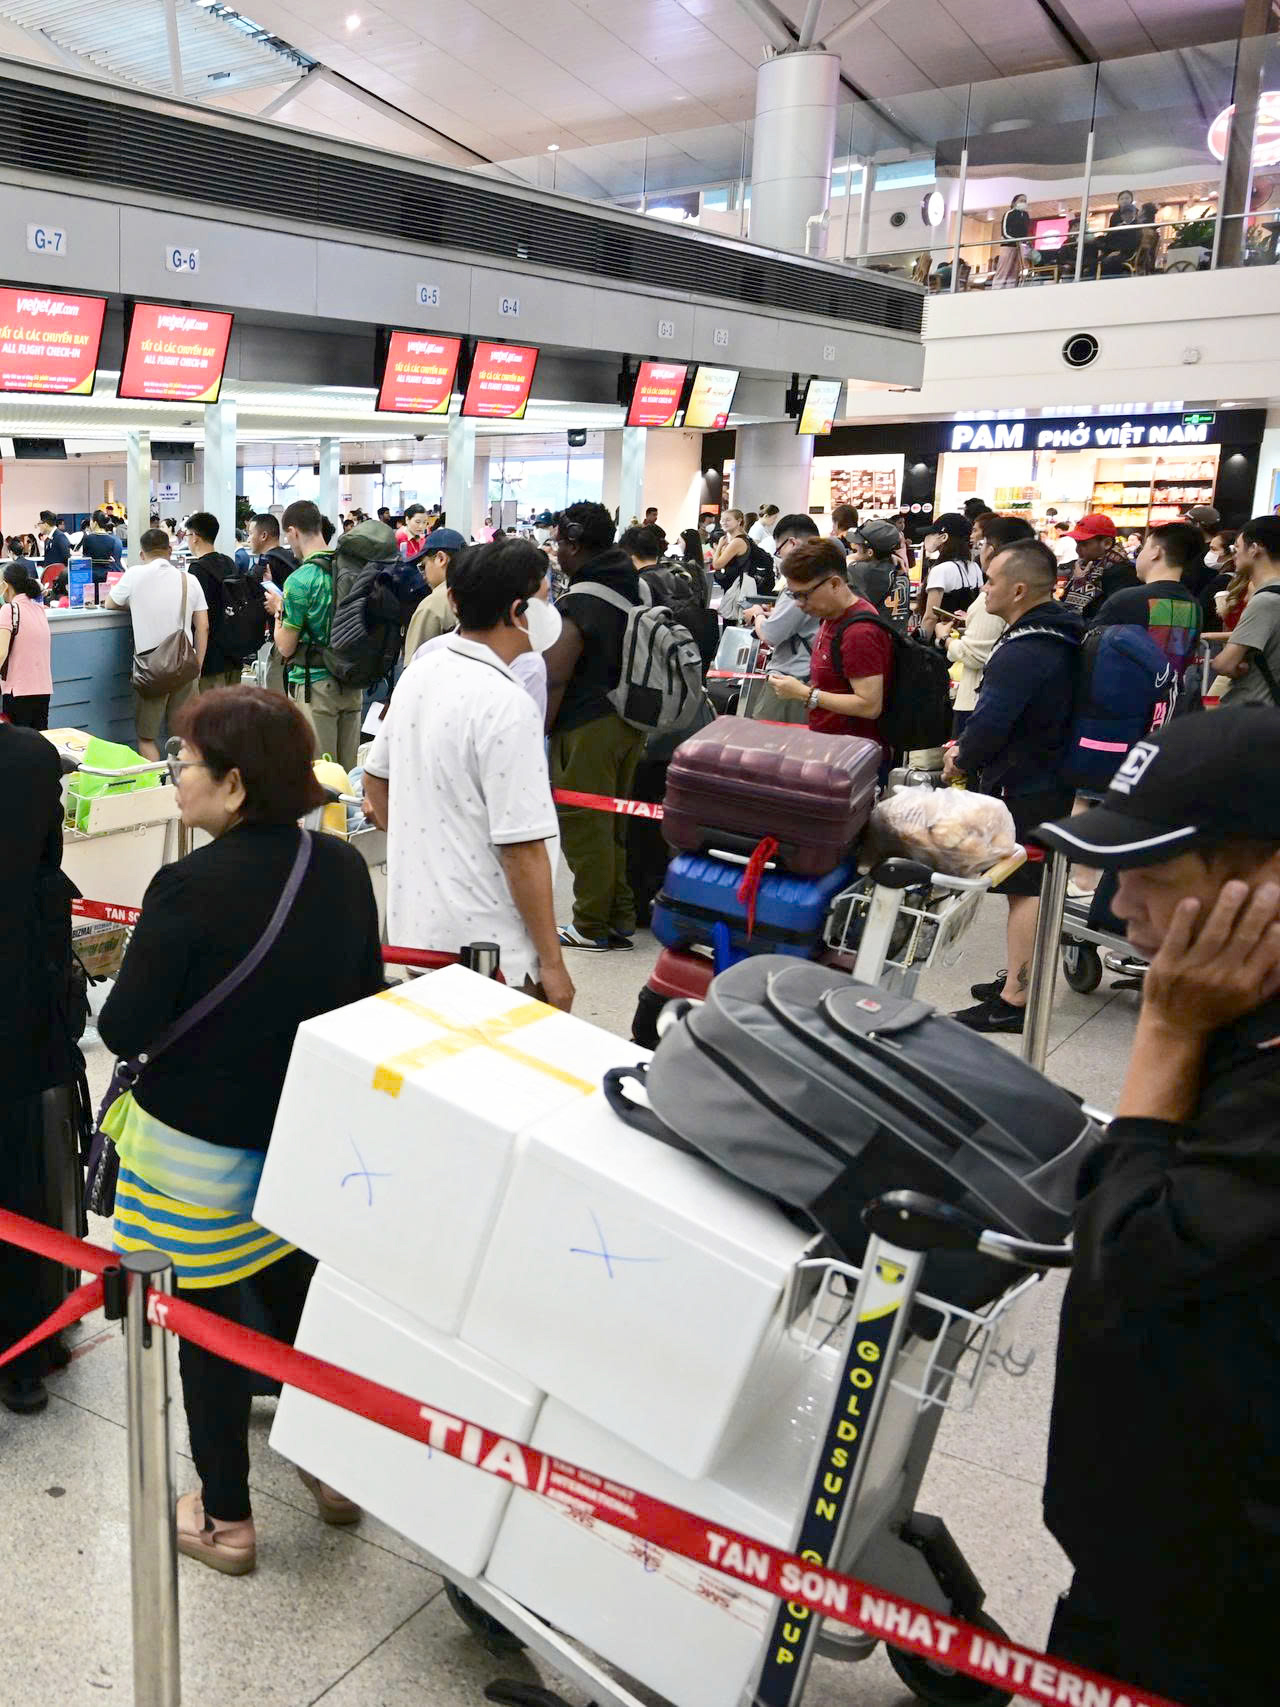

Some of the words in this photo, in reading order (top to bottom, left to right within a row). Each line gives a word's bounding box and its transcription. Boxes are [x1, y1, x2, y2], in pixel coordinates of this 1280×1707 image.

[35, 229, 62, 251] G-7
[172, 250, 196, 270] G-6
[420, 287, 437, 304] G-5
[503, 299, 517, 314] G-4
[13, 327, 24, 340] CẢ
[25, 328, 40, 341] CÁC
[42, 331, 72, 344] CHUYẾN
[74, 335, 89, 345] BAY
[1, 343, 16, 354] ALL
[18, 344, 45, 355] FLIGHT
[46, 346, 81, 358] CHECK-IN
[951, 423, 1025, 450] PAM
[1037, 421, 1091, 448] PHỞ
[1095, 421, 1145, 448] VIỆT
[1148, 424, 1208, 444] NAM
[613, 799, 651, 817] TIA
[105, 907, 125, 920] TAN
[128, 911, 141, 923] SO
[816, 1340, 881, 1521] GOLDSUN
[420, 1406, 529, 1487] TIA
[775, 1549, 823, 1665] GOUP
[706, 1531, 770, 1582] TAN
[781, 1563, 849, 1612] SON
[860, 1592, 960, 1655] NHAT
[969, 1634, 1150, 1707] INTERN
